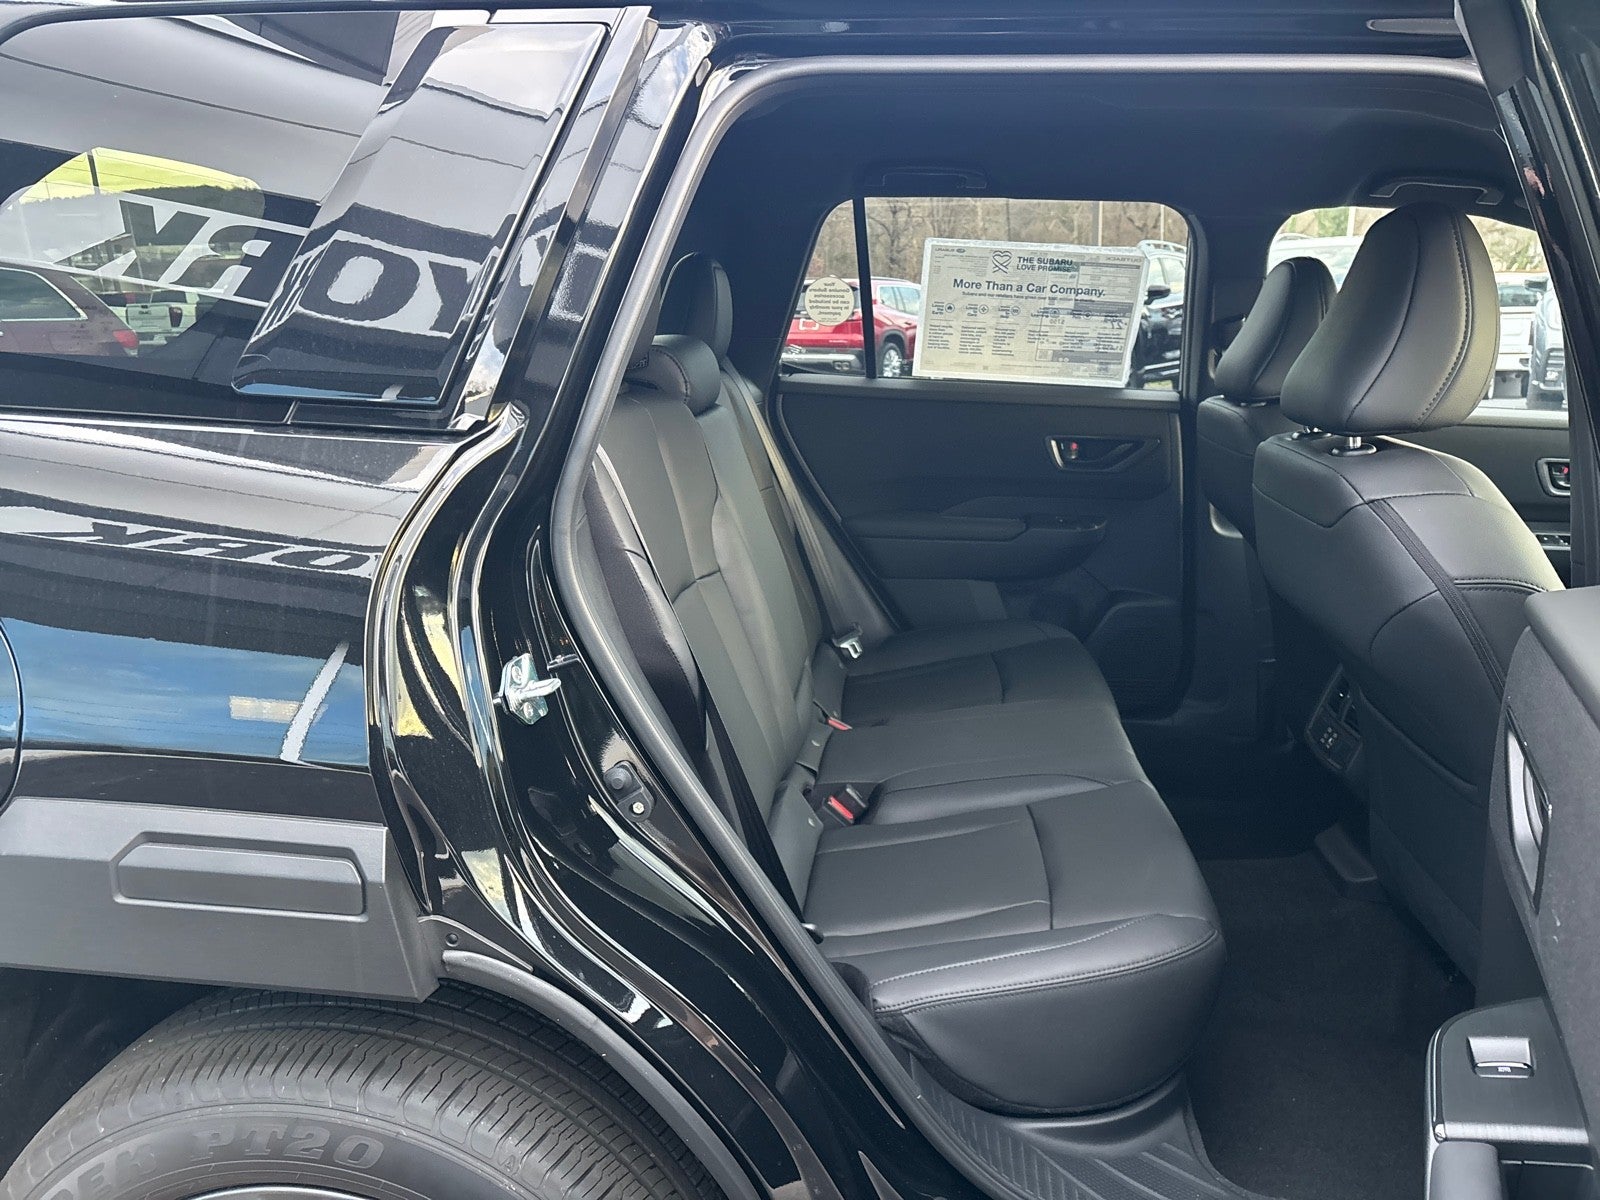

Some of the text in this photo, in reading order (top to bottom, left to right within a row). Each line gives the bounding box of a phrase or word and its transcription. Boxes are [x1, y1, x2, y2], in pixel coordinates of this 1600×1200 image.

[1017, 256, 1073, 266] THE SUBARU
[953, 278, 1106, 297] More Than a Car Company.
[190, 1122, 385, 1170] PT20
